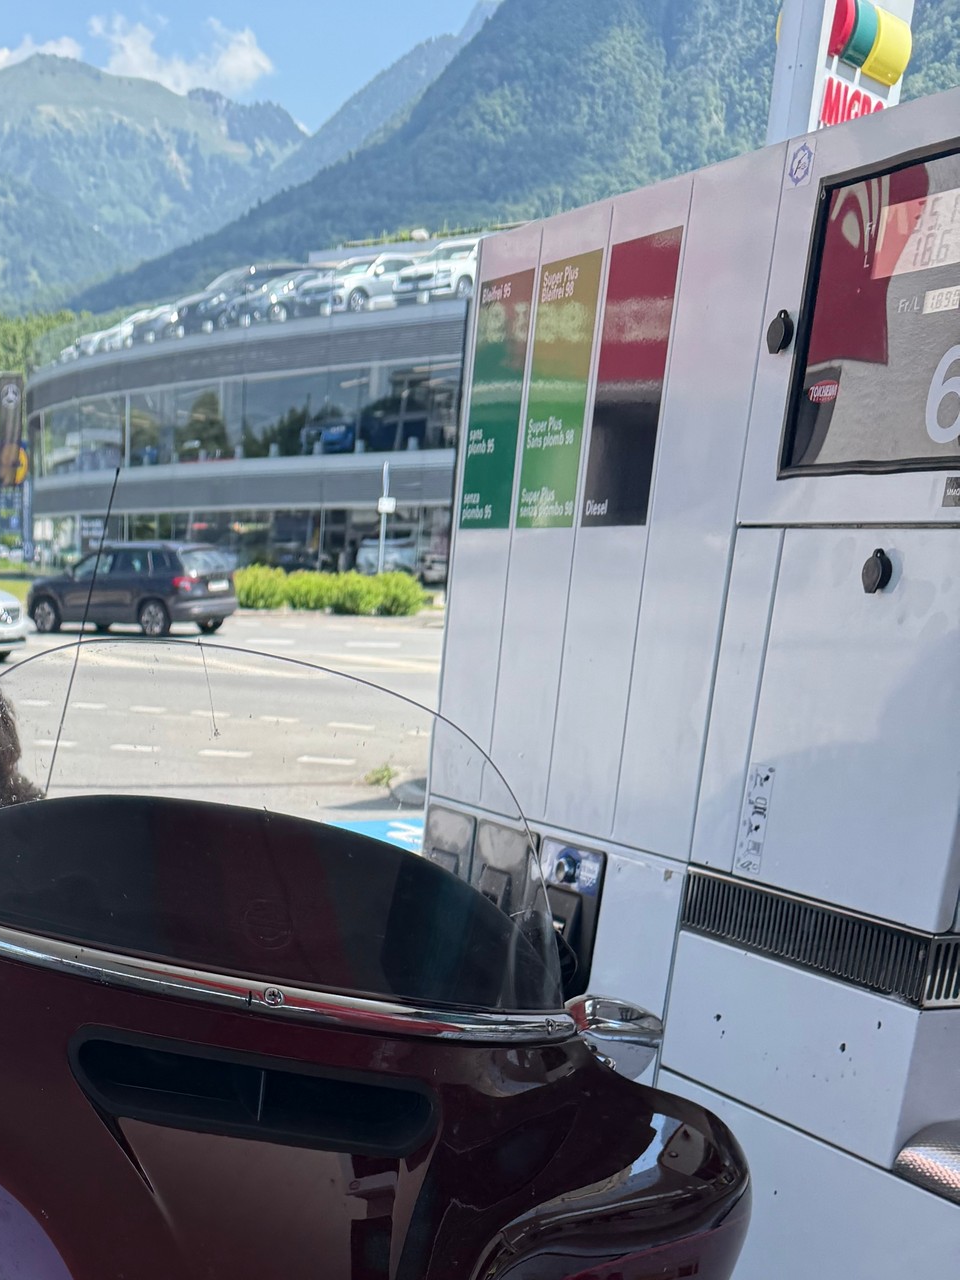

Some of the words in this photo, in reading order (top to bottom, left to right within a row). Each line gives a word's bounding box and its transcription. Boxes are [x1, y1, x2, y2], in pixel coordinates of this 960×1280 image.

[821, 77, 884, 126] MIG
[543, 270, 563, 288] Super
[564, 265, 579, 284] Plus
[503, 282, 511, 298] 95
[565, 281, 574, 297] 98
[926, 344, 960, 444] 6
[528, 418, 547, 435] Super
[548, 416, 562, 431] Plus
[470, 429, 483, 441] sans
[526, 433, 542, 449] Sans
[543, 431, 564, 450] plomb
[565, 428, 575, 445] 98
[468, 439, 486, 458] plomb
[487, 438, 495, 453] 95
[464, 493, 480, 505] senza
[521, 488, 540, 504] Super
[541, 486, 555, 501] Plus
[484, 504, 492, 519] 95
[565, 500, 574, 516] 98
[586, 499, 607, 516] Diesel
